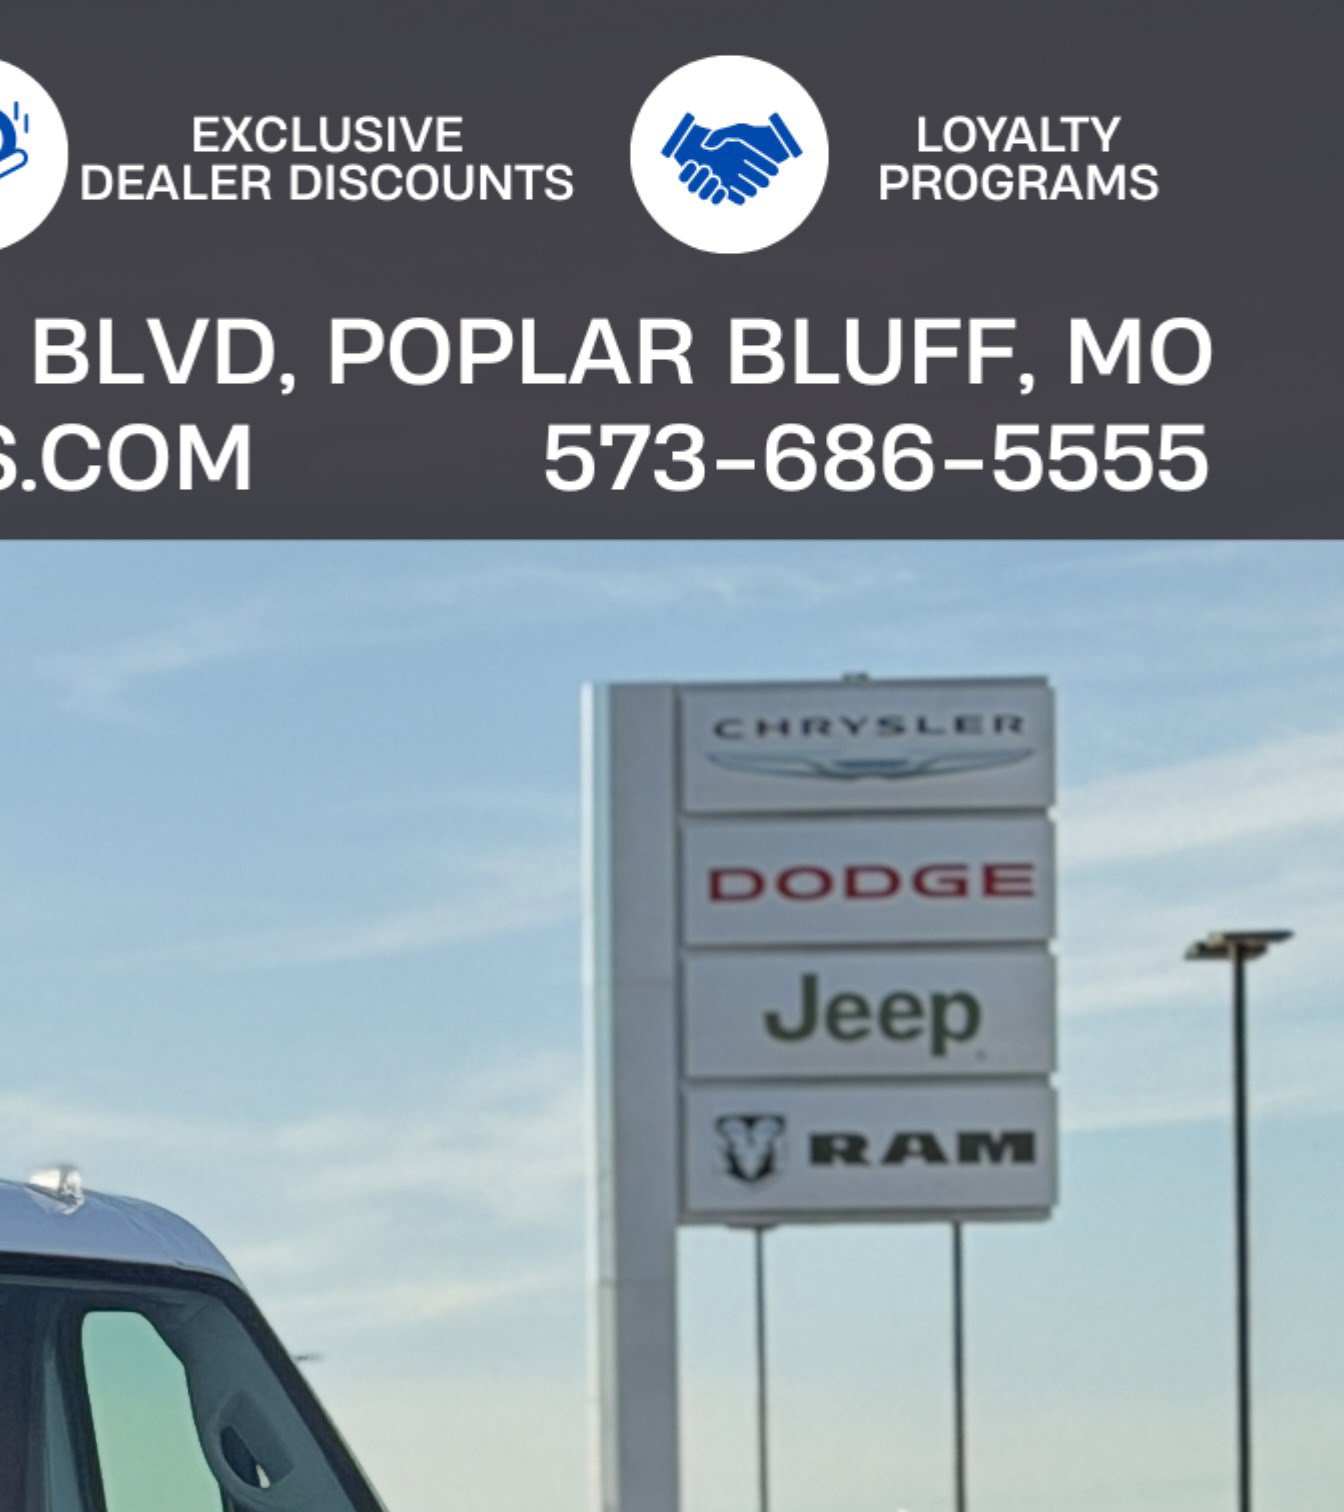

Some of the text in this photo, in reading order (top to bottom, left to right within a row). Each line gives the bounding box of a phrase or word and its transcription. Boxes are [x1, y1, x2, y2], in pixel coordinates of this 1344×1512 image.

[712, 713, 1028, 741] CHRYSLER
[707, 863, 1037, 903] DODGE
[763, 972, 982, 1058] Jeep
[808, 1130, 1037, 1167] RAM
